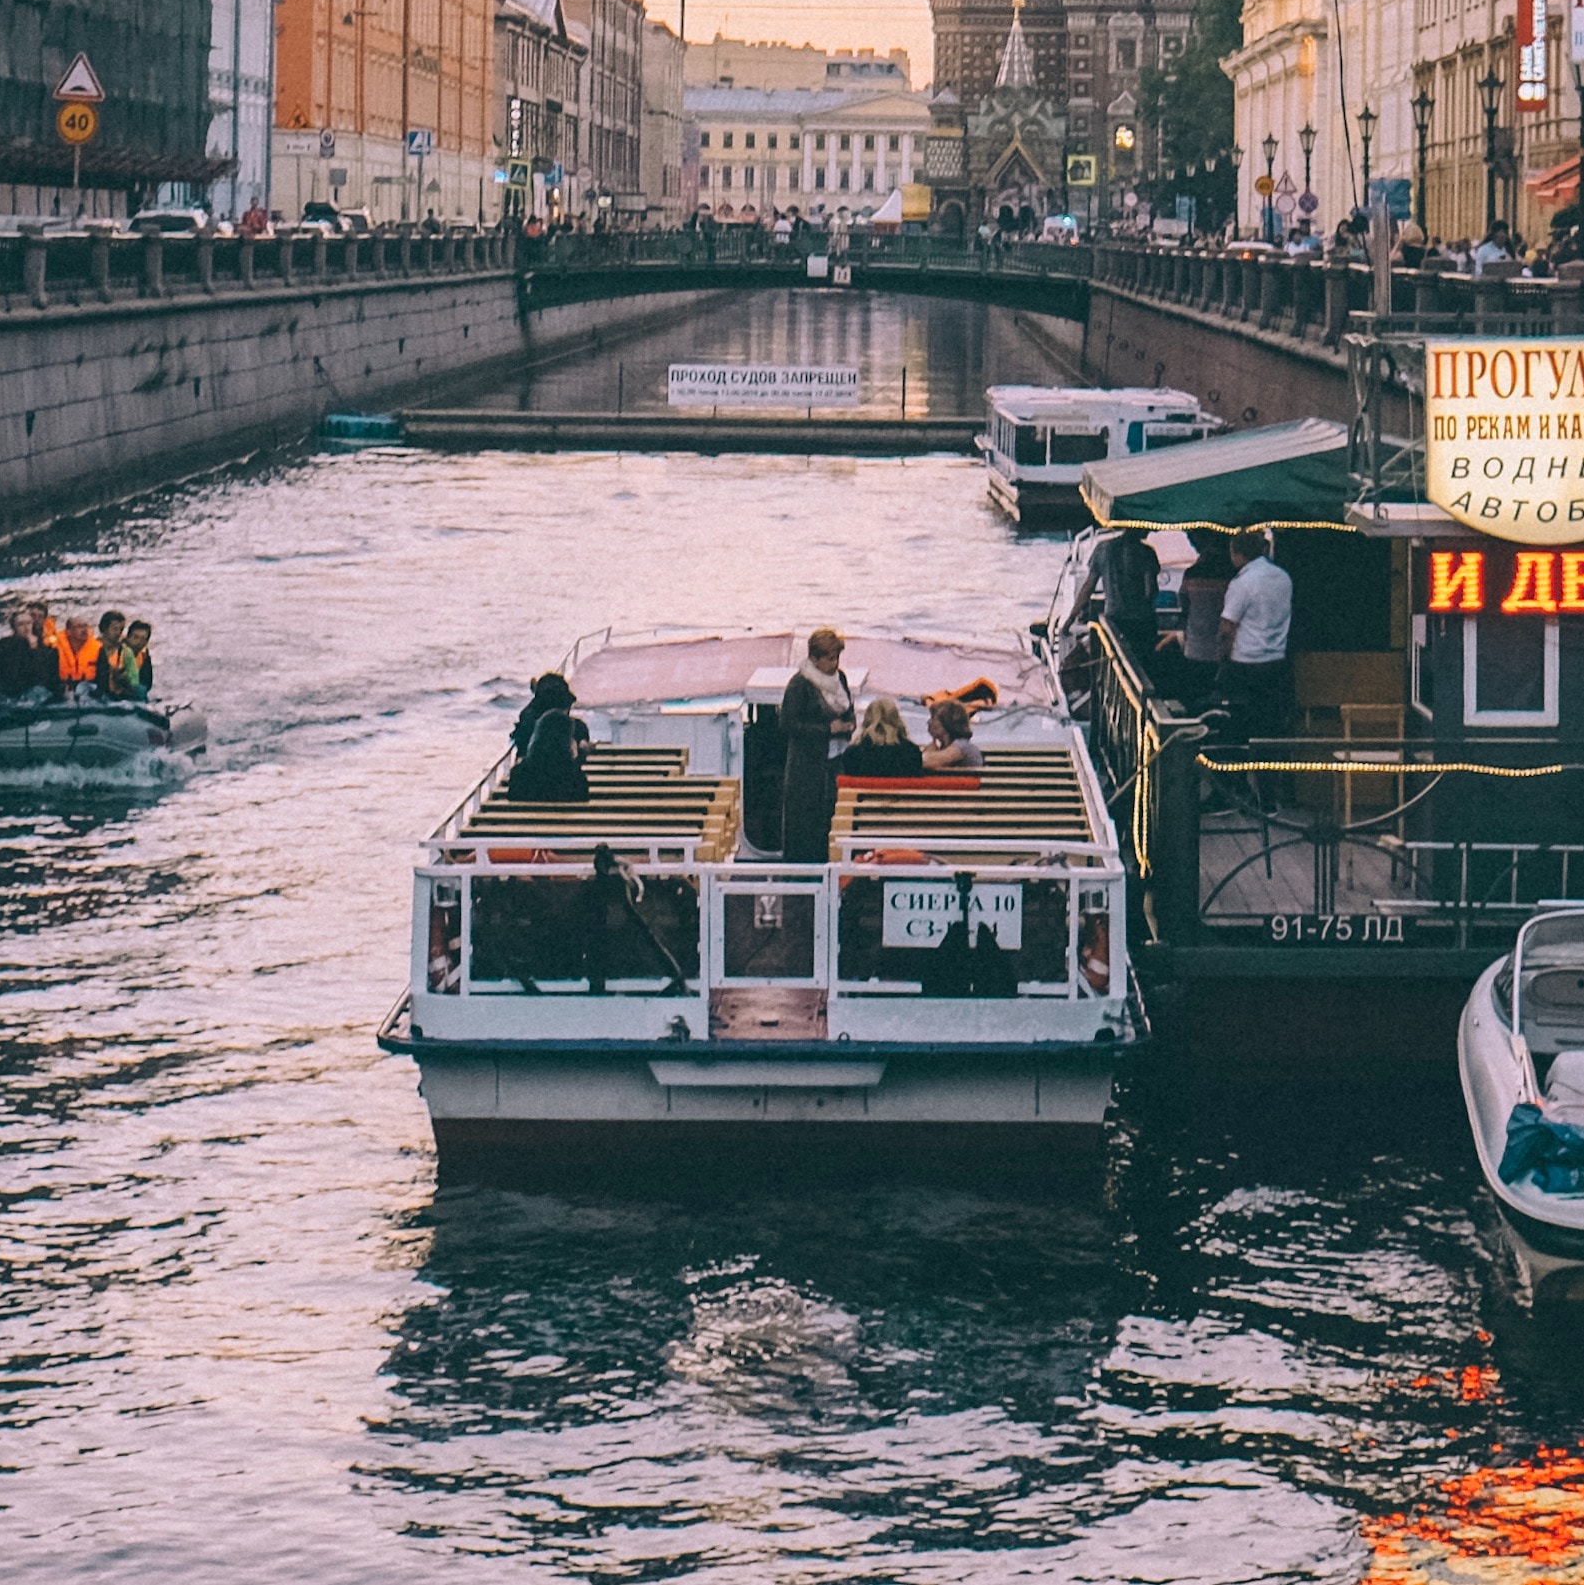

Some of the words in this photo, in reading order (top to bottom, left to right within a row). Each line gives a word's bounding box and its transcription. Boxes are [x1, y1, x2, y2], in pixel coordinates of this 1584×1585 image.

[65, 113, 89, 131] 40
[671, 370, 727, 385] ПРОХОД
[731, 370, 777, 385] СУДОВ
[781, 371, 857, 387] ЗАПРЕЩЕН
[1434, 416, 1457, 441] ПО
[1466, 415, 1531, 440] РЕКАМ
[1539, 414, 1551, 439] И
[1429, 551, 1484, 611] И
[890, 892, 979, 912] СИЕРА
[995, 894, 1015, 912] 10
[1271, 915, 1353, 941] 91-75
[1361, 916, 1404, 942] ЛД
